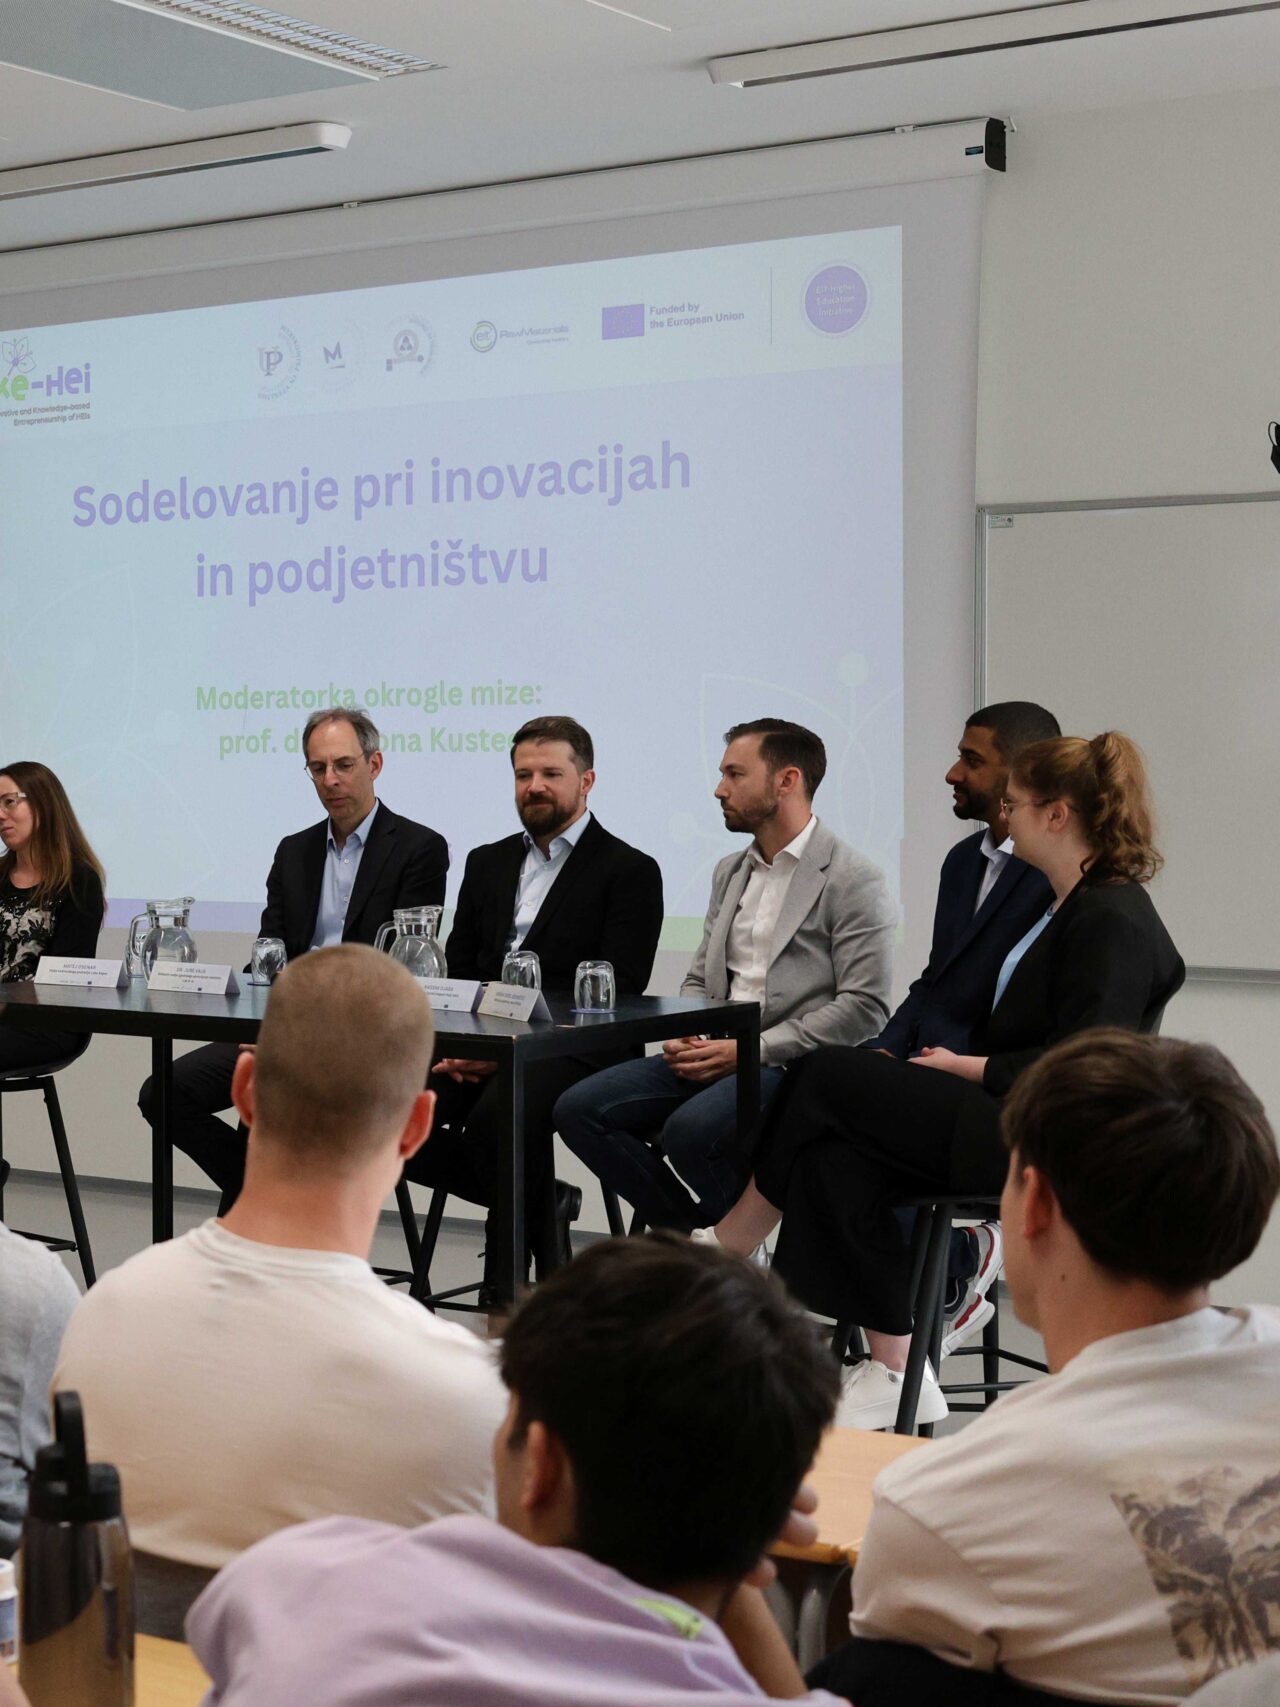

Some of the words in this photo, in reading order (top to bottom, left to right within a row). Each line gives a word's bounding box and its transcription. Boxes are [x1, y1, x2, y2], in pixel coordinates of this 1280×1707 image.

[649, 304, 685, 315] Funded
[687, 302, 700, 312] by
[649, 319, 665, 329] the
[666, 315, 713, 327] European
[715, 311, 745, 322] Union
[20, 407, 32, 416] and
[73, 467, 340, 528] Sodelovanje
[355, 460, 415, 521] pri
[432, 441, 692, 506] inovacijah
[197, 553, 234, 598] in
[249, 539, 549, 608] podjetništvu
[195, 682, 357, 711] Moderatorka
[364, 680, 463, 714] okrogle
[470, 679, 543, 707] mize:
[218, 728, 278, 761] prof.
